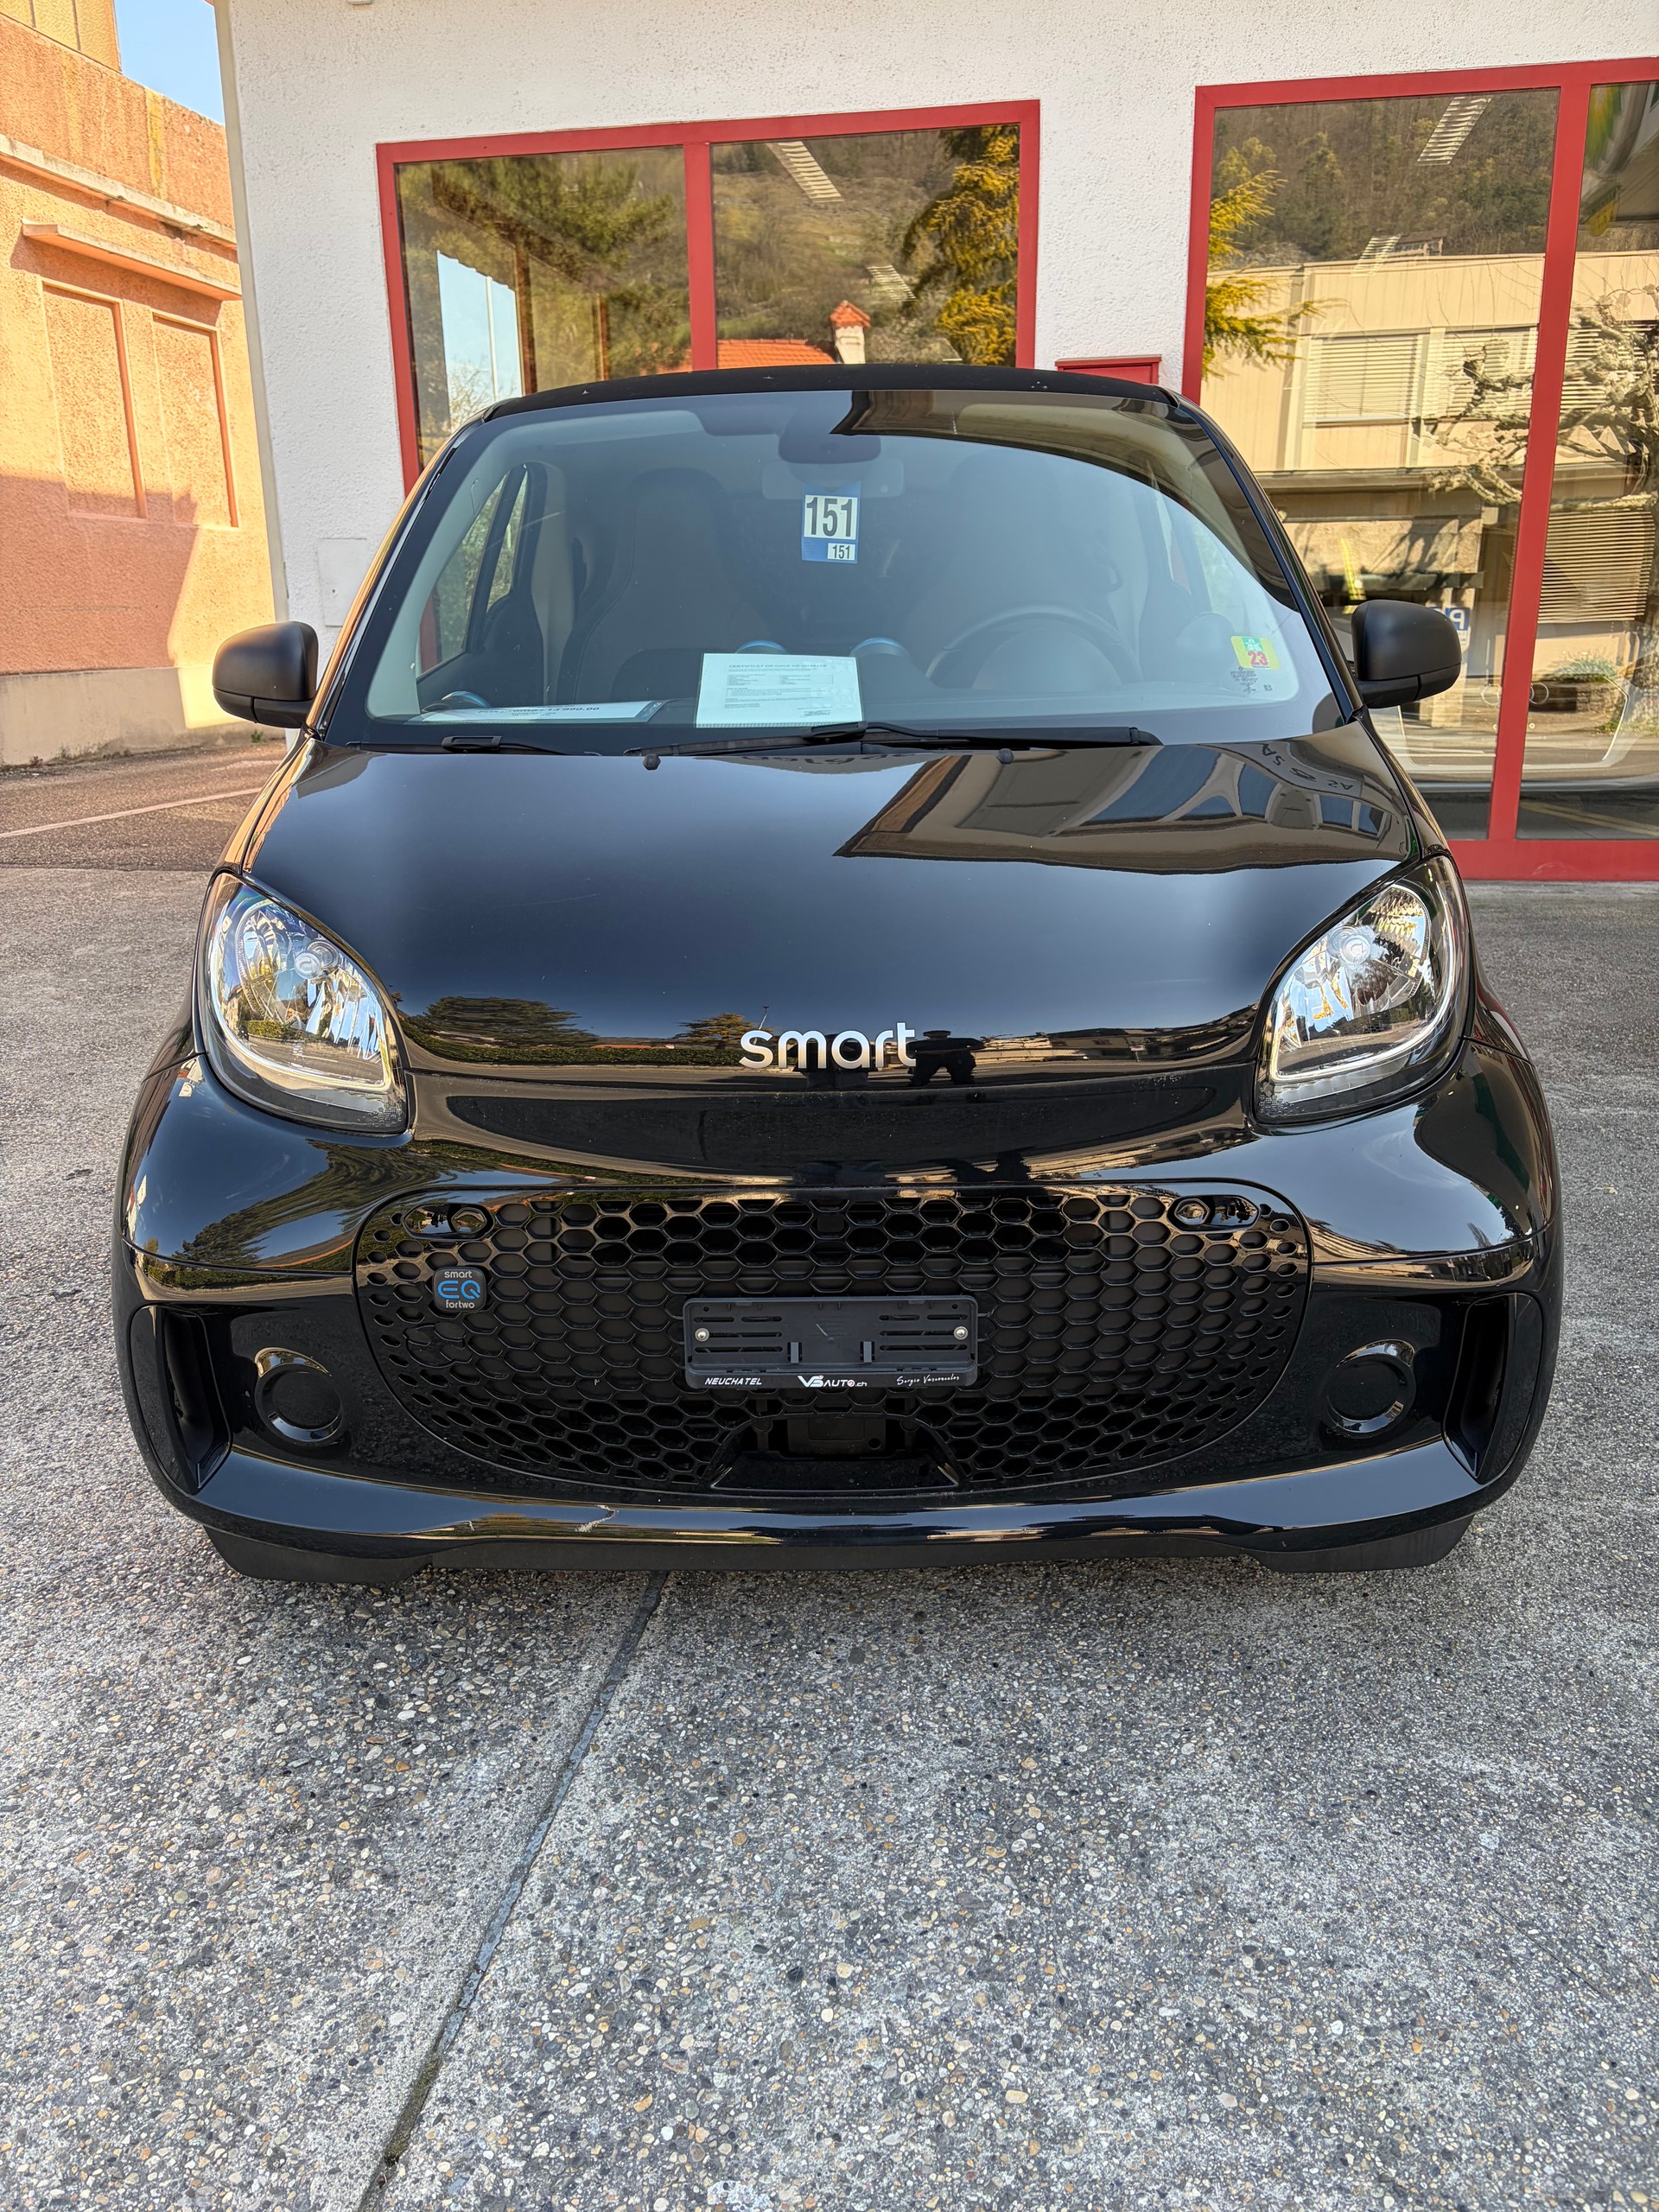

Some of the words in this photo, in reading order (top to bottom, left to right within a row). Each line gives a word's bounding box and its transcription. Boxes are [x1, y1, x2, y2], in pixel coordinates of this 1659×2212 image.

[806, 497, 853, 537] 151
[832, 544, 850, 559] 151
[1248, 651, 1268, 665] 23
[739, 1022, 917, 1069] smart
[444, 1270, 473, 1279] smart
[437, 1280, 480, 1300] EQ
[445, 1300, 474, 1308] fortwo
[896, 1376, 920, 1386] Sergio
